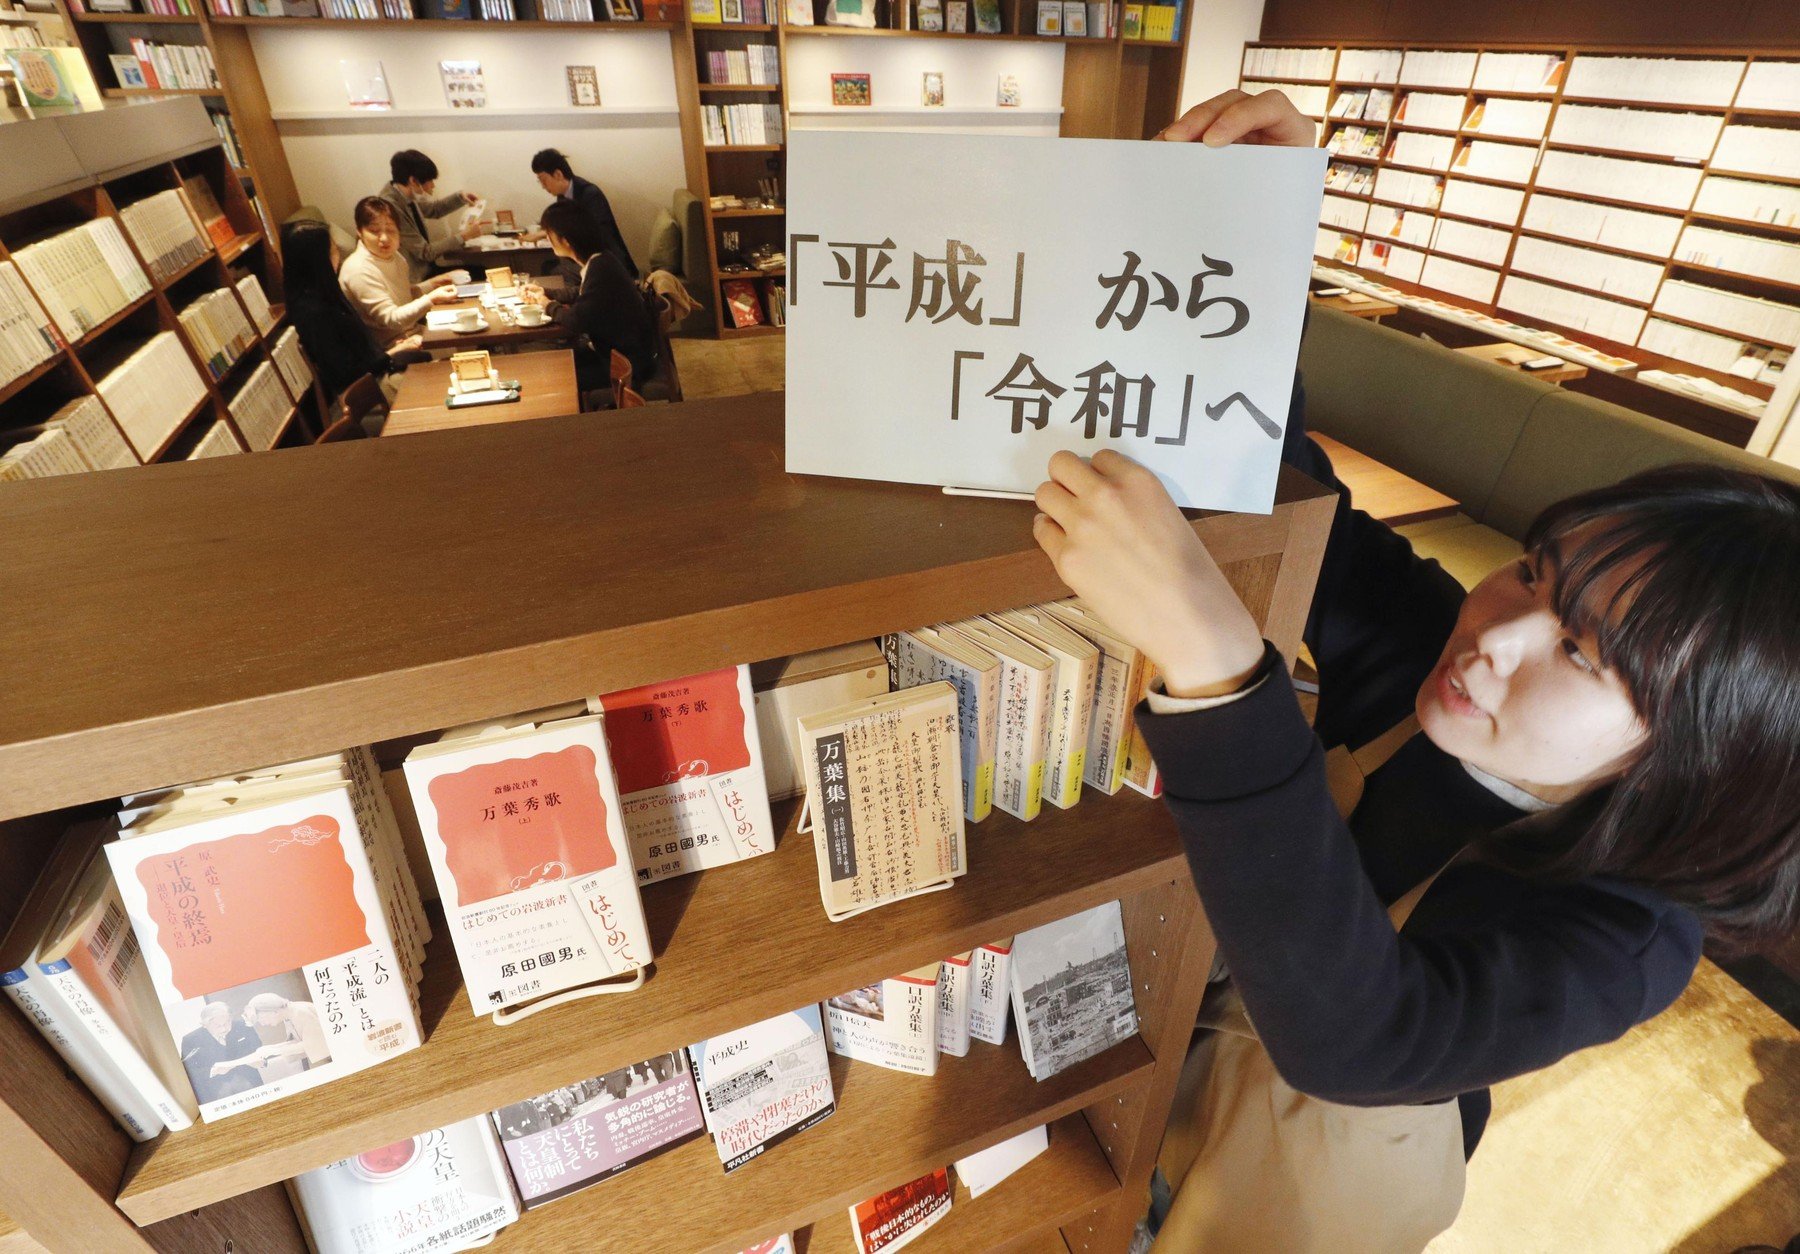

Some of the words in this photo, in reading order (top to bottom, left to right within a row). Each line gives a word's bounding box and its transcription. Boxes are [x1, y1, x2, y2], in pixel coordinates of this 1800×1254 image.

[789, 234, 1026, 328] 「平成」
[1094, 250, 1251, 339] から
[950, 350, 1283, 447] 「令和」へ
[642, 700, 708, 722] 万葉秀歌
[820, 741, 847, 804] 万葉集
[480, 792, 562, 822] 万葉秀歌
[649, 833, 709, 859] 原田國男
[164, 856, 212, 947] 平成の終焉
[462, 894, 568, 930] はじめての岩波新書
[367, 948, 390, 986] 二人の
[501, 946, 573, 978] 原田國男
[314, 966, 348, 1035] 何だったのか
[342, 956, 376, 1032] 「平成流」とは
[708, 1039, 749, 1066] 平成史
[604, 1080, 690, 1124] 気鋭の研究者が
[607, 1093, 691, 1134] 多角的に論じる。
[720, 1078, 829, 1145] 停滞や閉塞だけの
[553, 1125, 582, 1171] にとって
[571, 1118, 599, 1161] 私たち
[726, 1144, 765, 1170] 平凡社新書
